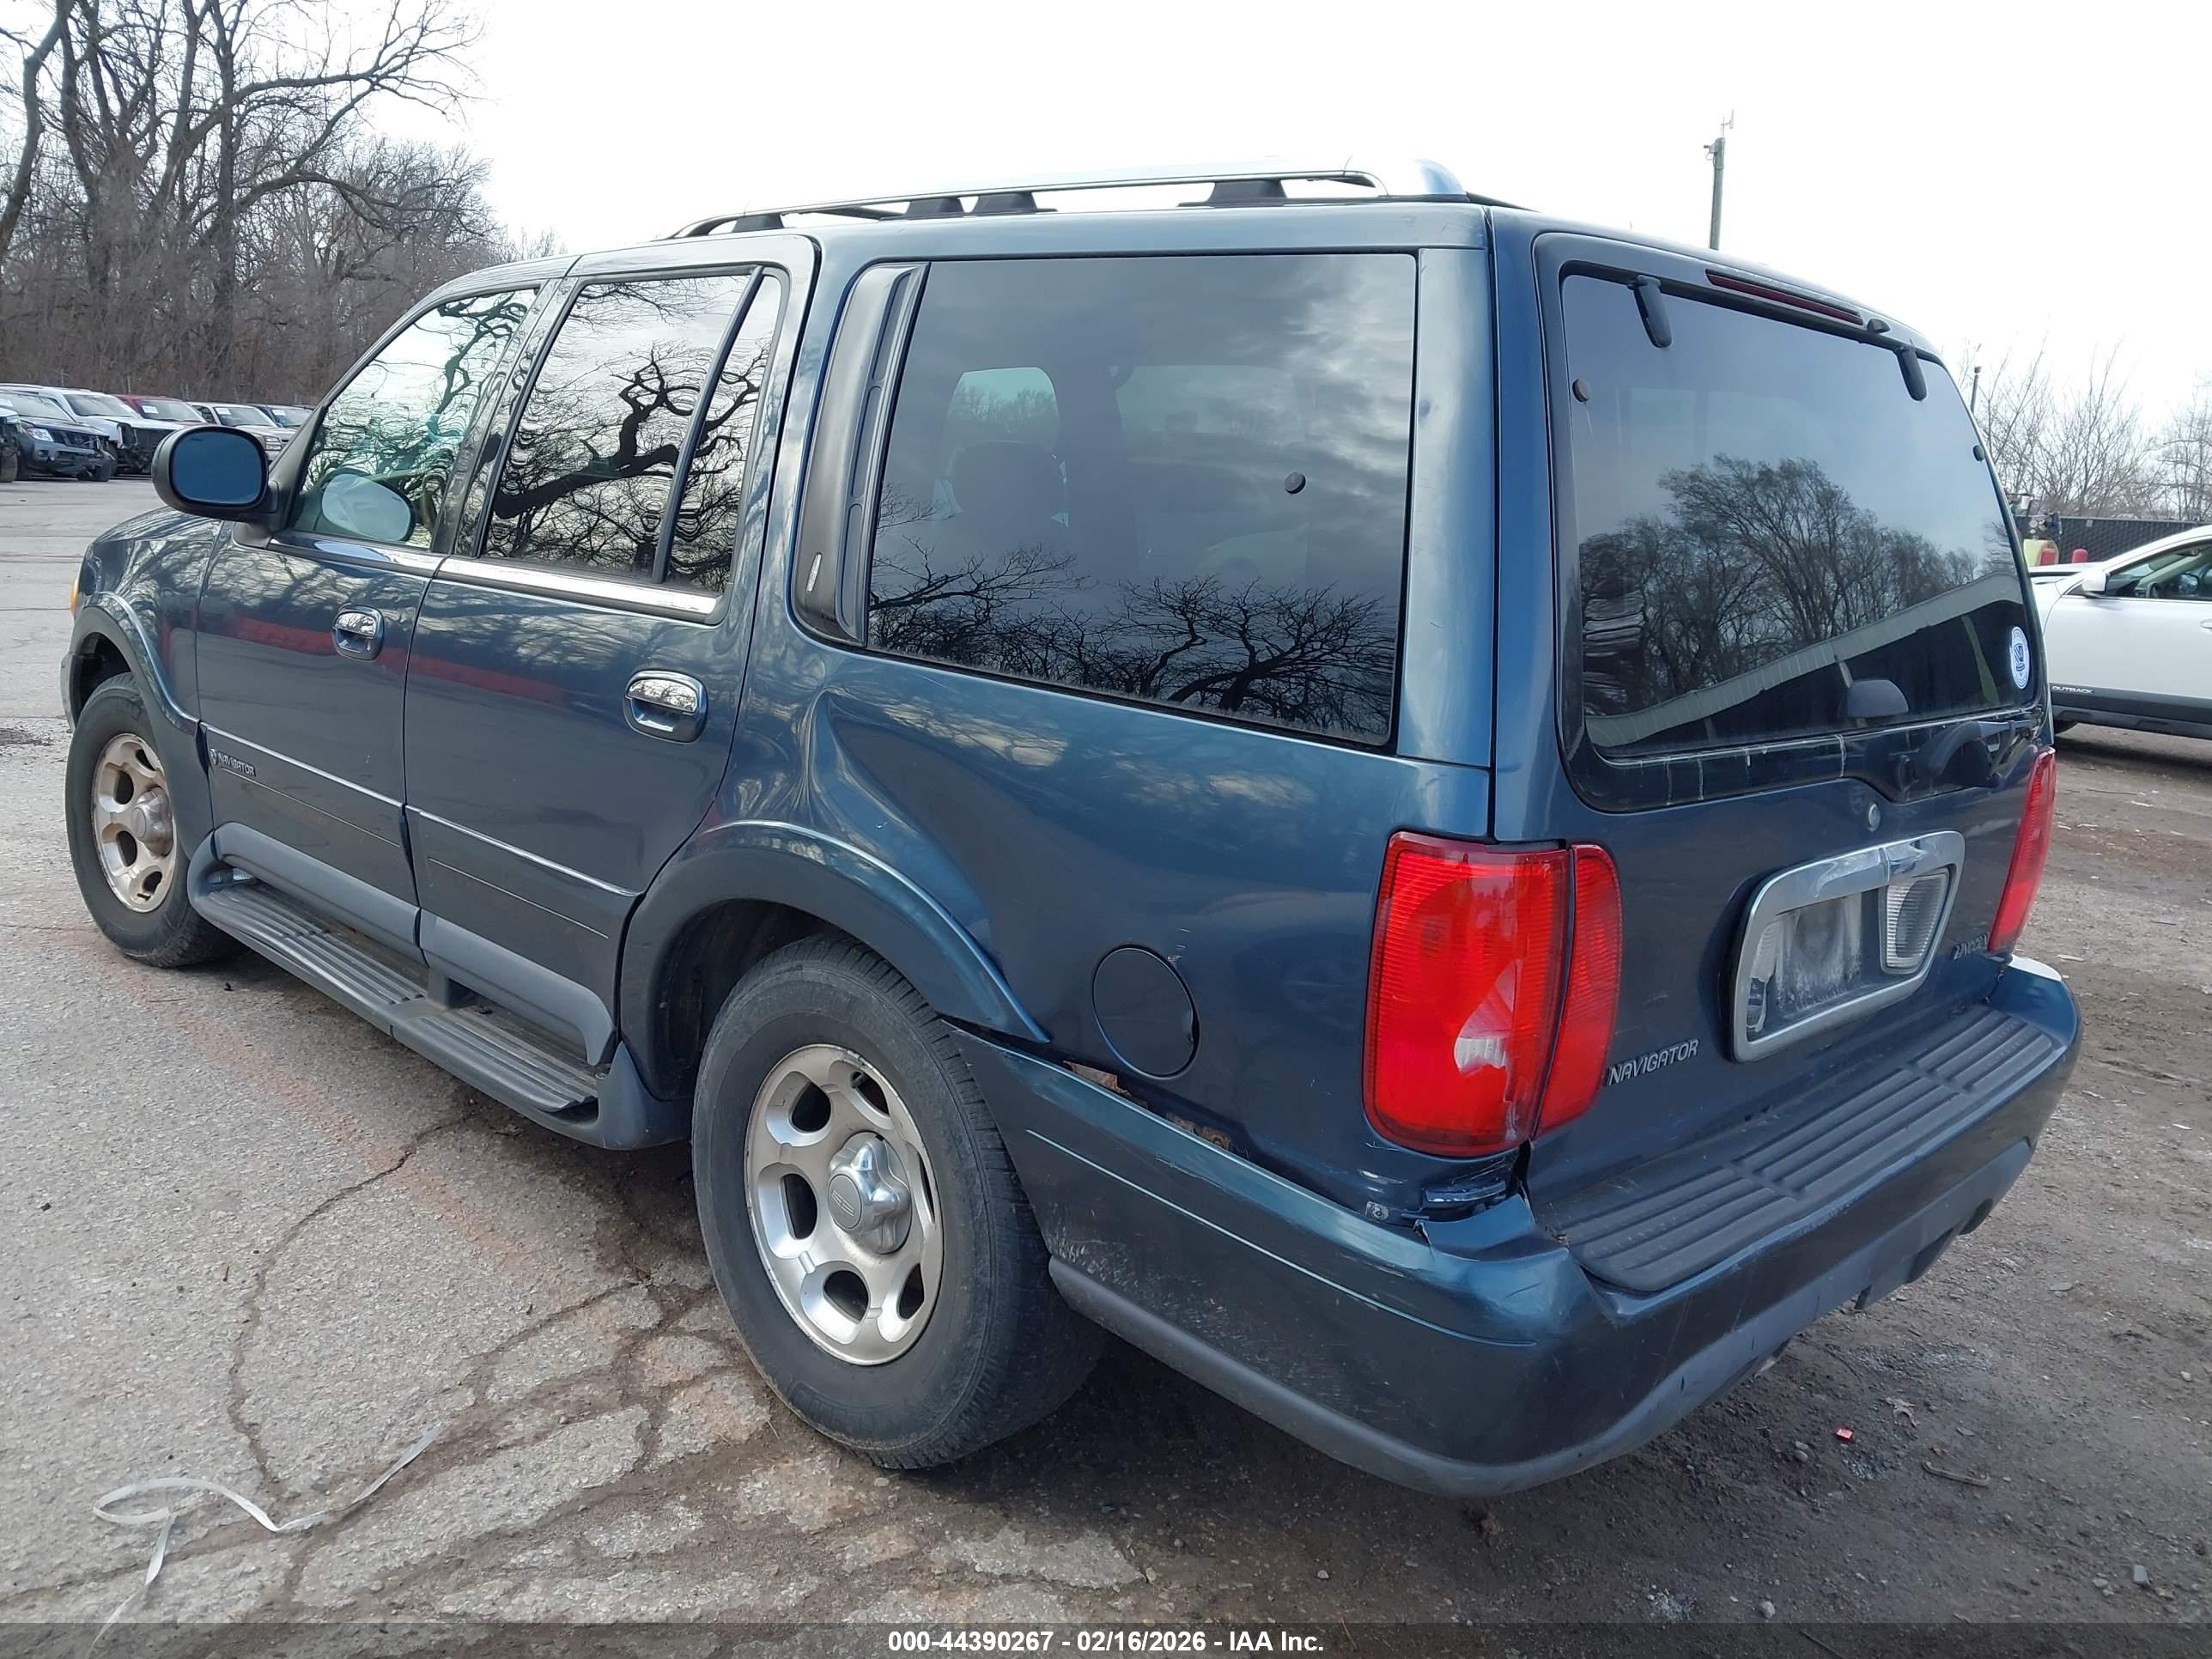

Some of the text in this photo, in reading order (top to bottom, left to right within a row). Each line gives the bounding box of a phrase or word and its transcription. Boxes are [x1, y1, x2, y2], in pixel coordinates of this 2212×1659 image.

[2052, 685, 2094, 694] OUTBACK
[218, 752, 255, 776] NAVIGATOR
[1608, 1038, 1699, 1086] NAVIGATOR
